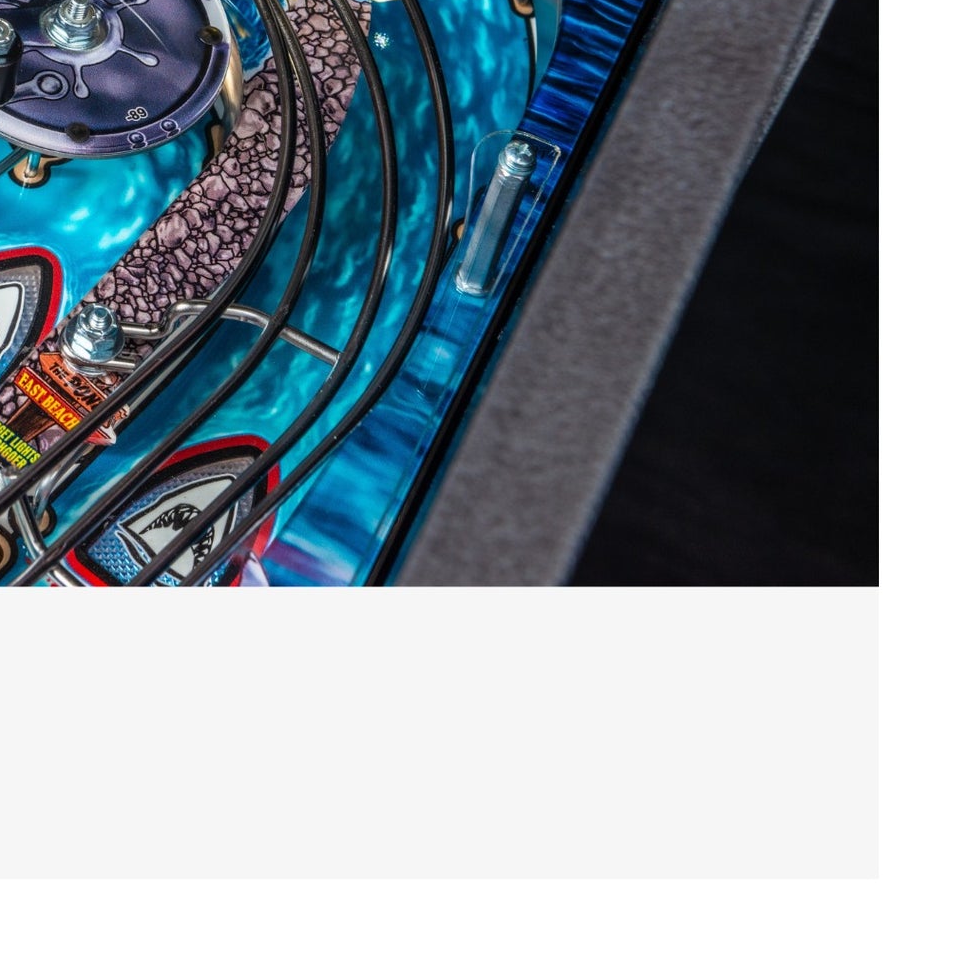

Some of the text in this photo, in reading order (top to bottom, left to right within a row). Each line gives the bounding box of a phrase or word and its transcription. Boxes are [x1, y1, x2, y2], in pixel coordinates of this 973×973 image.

[126, 107, 147, 121] -89
[18, 372, 80, 431] EAST BEACH
[70, 374, 102, 411] PON
